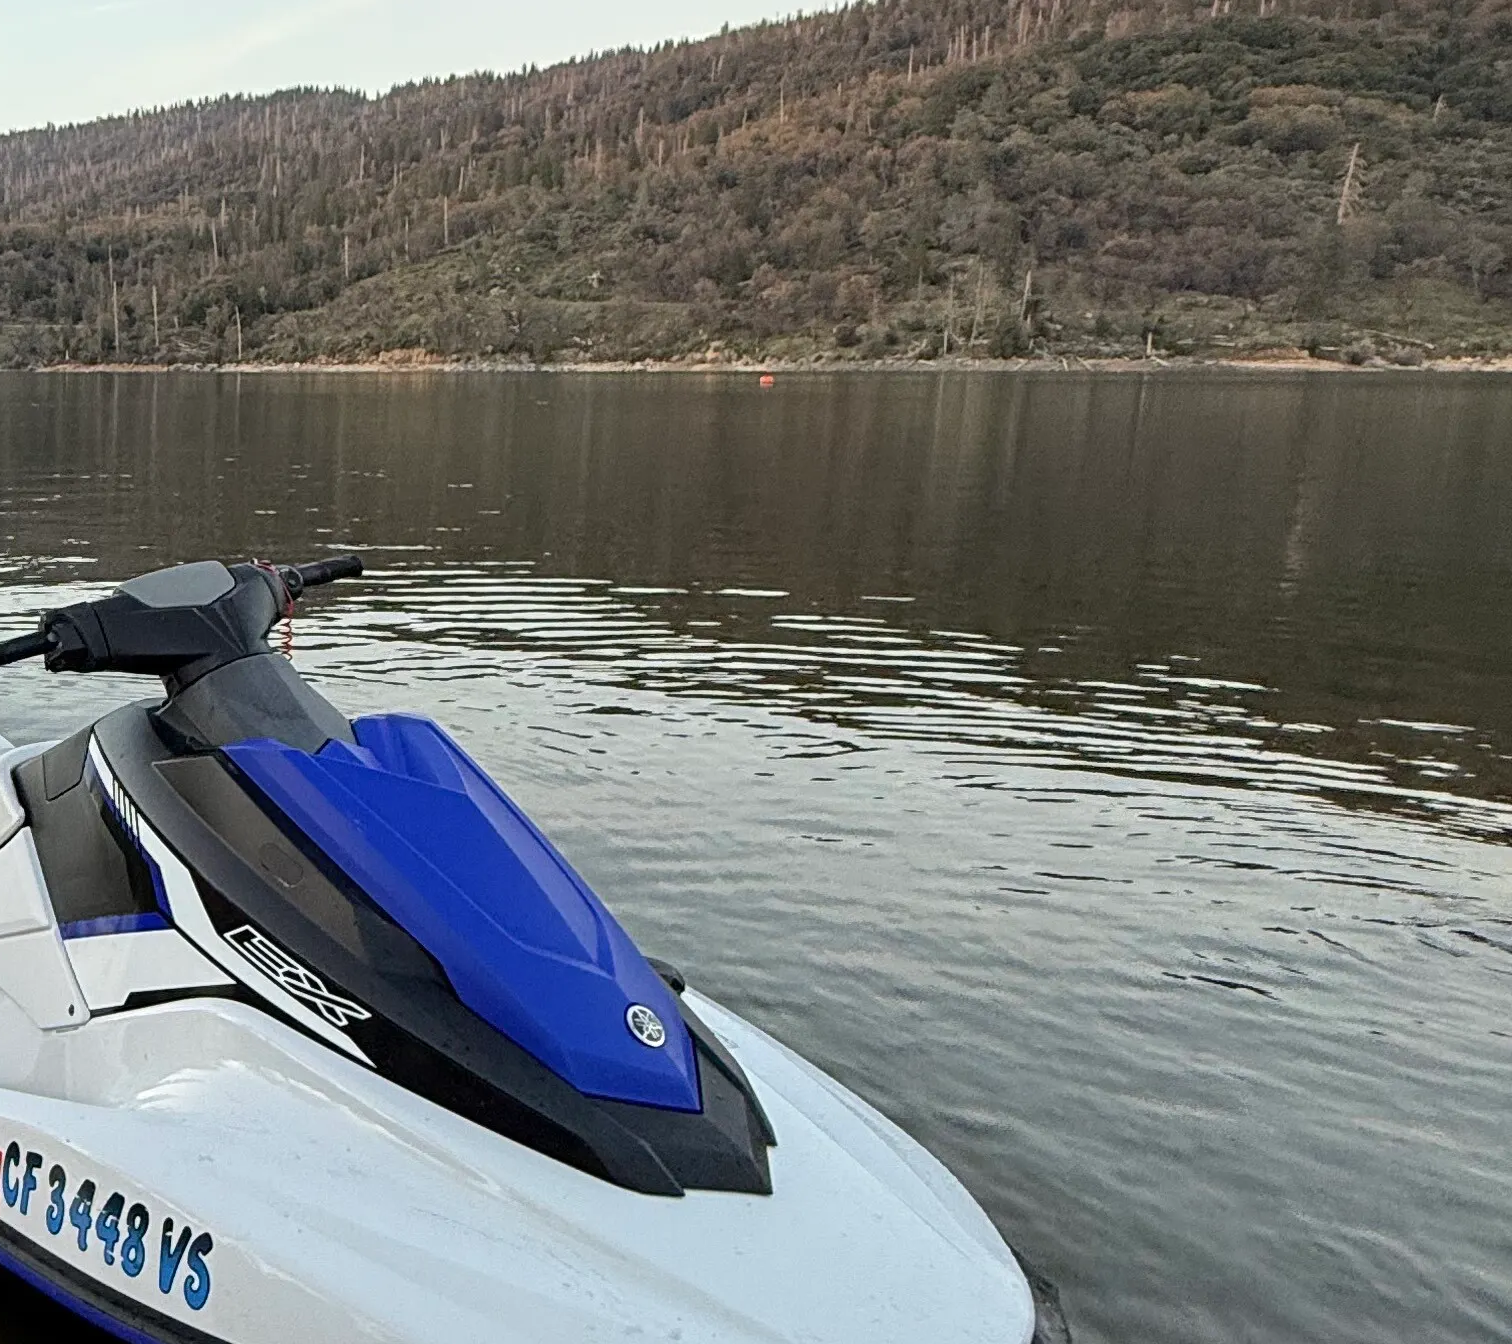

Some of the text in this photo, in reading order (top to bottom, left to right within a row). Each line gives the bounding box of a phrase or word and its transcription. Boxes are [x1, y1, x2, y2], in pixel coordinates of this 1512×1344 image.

[223, 924, 372, 1027] EX
[3, 1141, 214, 1311] CF 3448 VS
